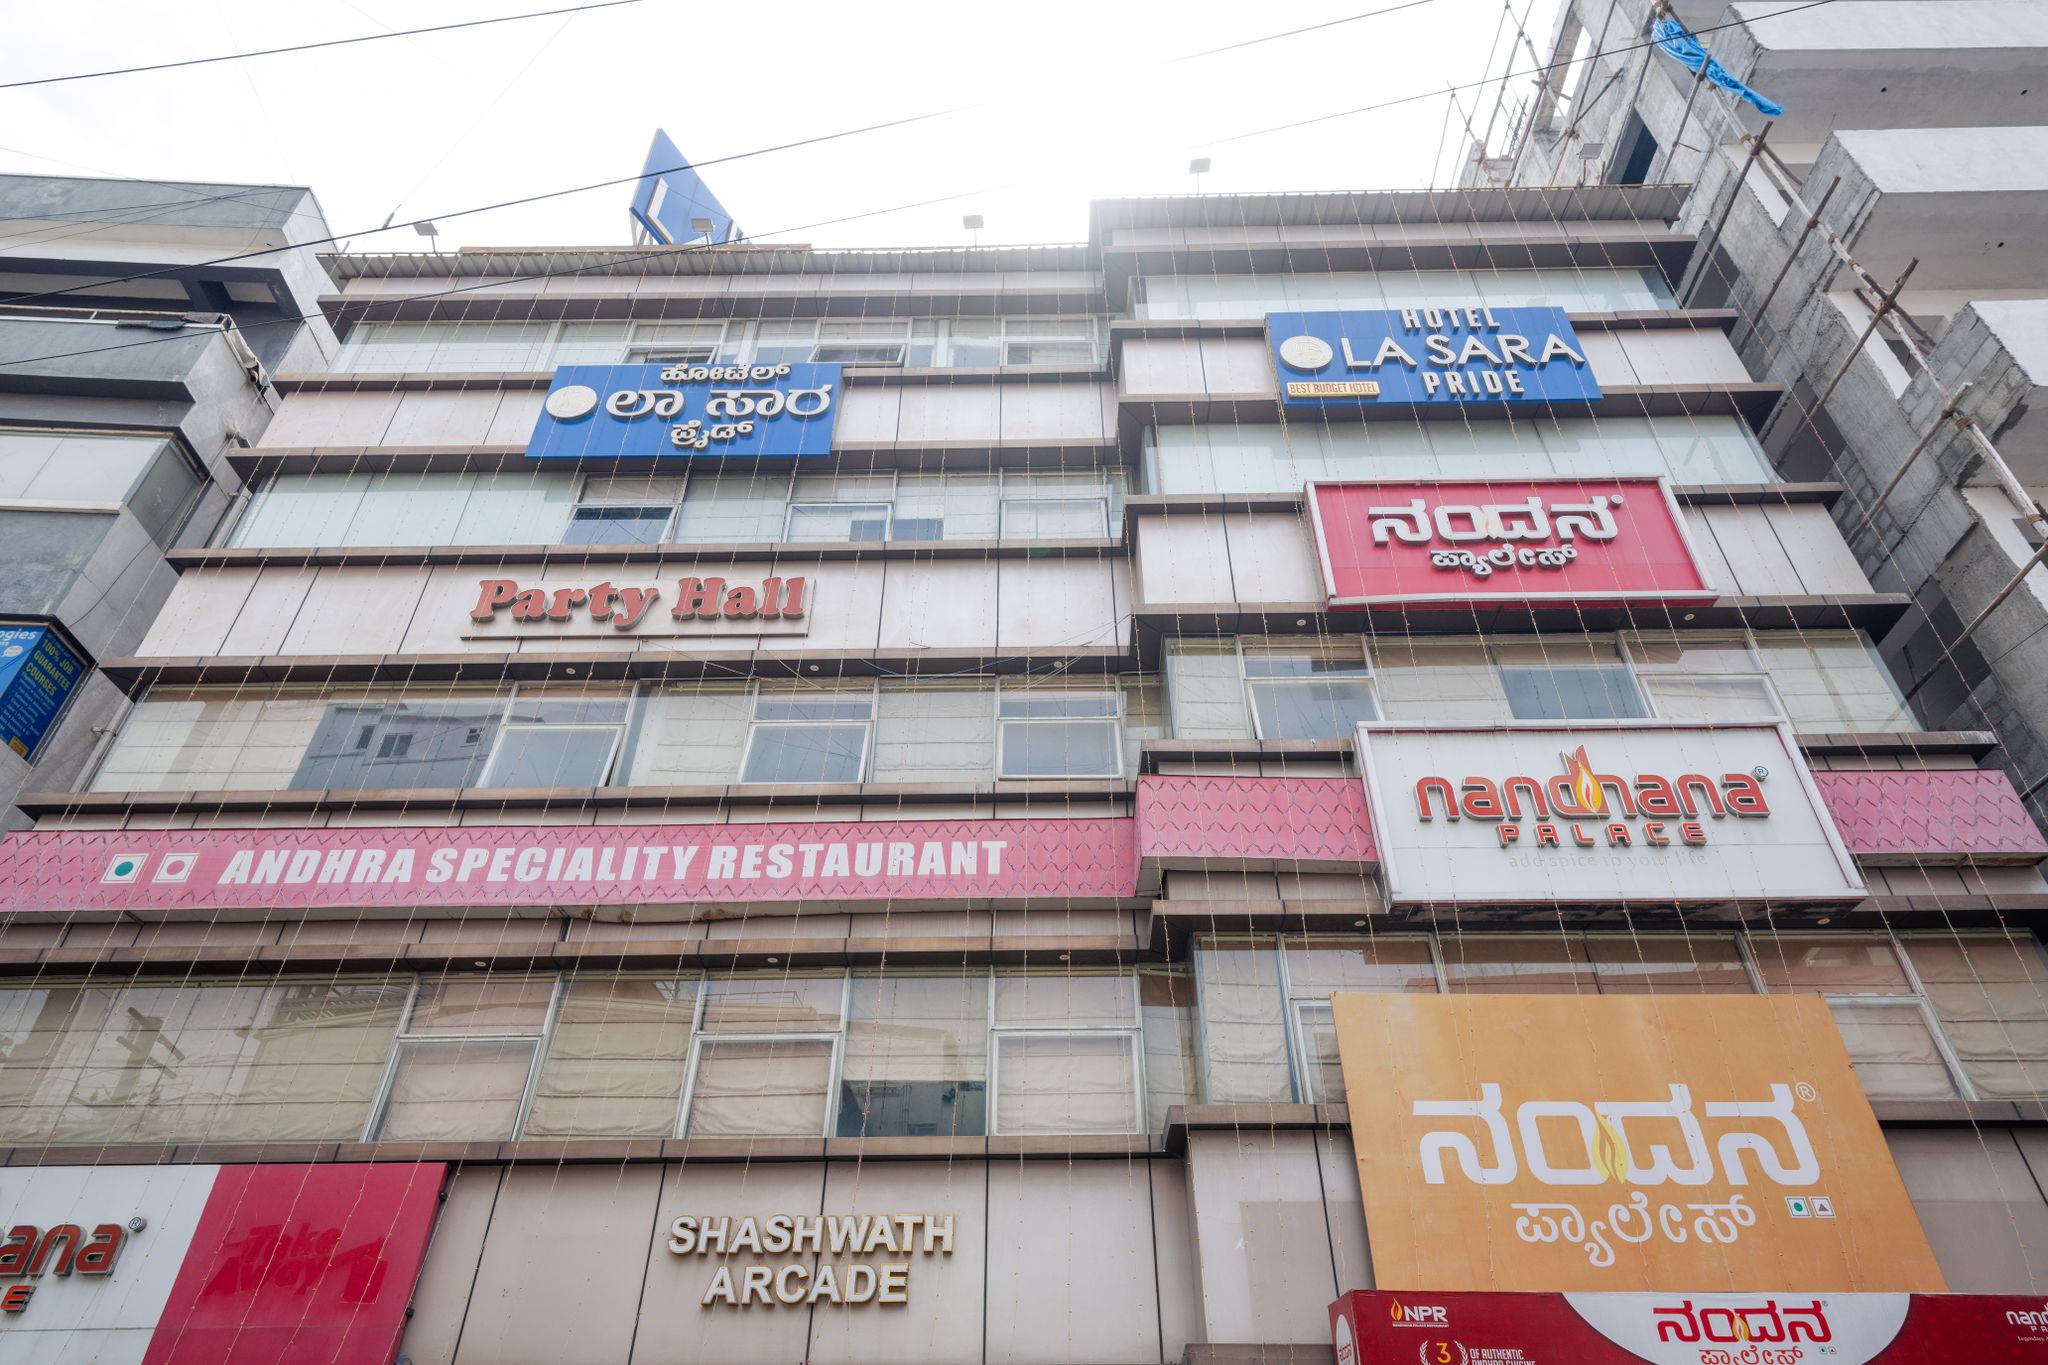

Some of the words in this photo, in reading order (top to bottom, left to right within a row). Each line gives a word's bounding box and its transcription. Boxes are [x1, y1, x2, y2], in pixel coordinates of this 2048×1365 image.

[1401, 306, 1500, 330] HOTEL
[1340, 336, 1418, 370] LA
[1425, 334, 1586, 368] SARA
[660, 363, 792, 384] ಹೋಟೆಲ್
[1289, 383, 1313, 394] BEST
[1313, 383, 1348, 393] BUDGET
[1349, 382, 1377, 393] HOTEL
[1422, 370, 1525, 398] PRIDE
[605, 388, 685, 419] ಲಾ
[705, 384, 833, 419] ಸಾರ
[671, 420, 754, 449] ಪ್ರೈಡ್
[1367, 496, 1617, 546] ನಂದನ
[1430, 543, 1578, 579] ಪ್ಯಾಲೇಸ್
[469, 580, 661, 631] Party
[671, 577, 806, 620] Hall
[34, 650, 71, 691] GUARANTEE
[42, 639, 61, 663] 100%
[59, 659, 74, 675] JOB
[26, 662, 57, 697] COURSES
[1415, 744, 1772, 822] nandhana
[1496, 822, 1708, 848] PALACE
[217, 848, 416, 885] ANDHRA
[425, 846, 699, 882] SPECIALITY
[706, 840, 1007, 879] RESTAURANT
[1549, 852, 1599, 872] spice
[1676, 849, 1708, 866] life
[1413, 1083, 1820, 1185] ನಂದನ
[668, 1214, 956, 1257] SHASHWATH
[1511, 1191, 1756, 1267] ಪ್ಯಾಲೇಸ್
[701, 1262, 909, 1306] ARCADE
[1404, 1305, 1448, 1322] NPR
[1653, 1300, 1832, 1343] ನಂದನ
[1436, 1342, 1452, 1364] 3
[1469, 1348, 1480, 1359] OF
[1481, 1348, 1524, 1360] AUTHENTIC
